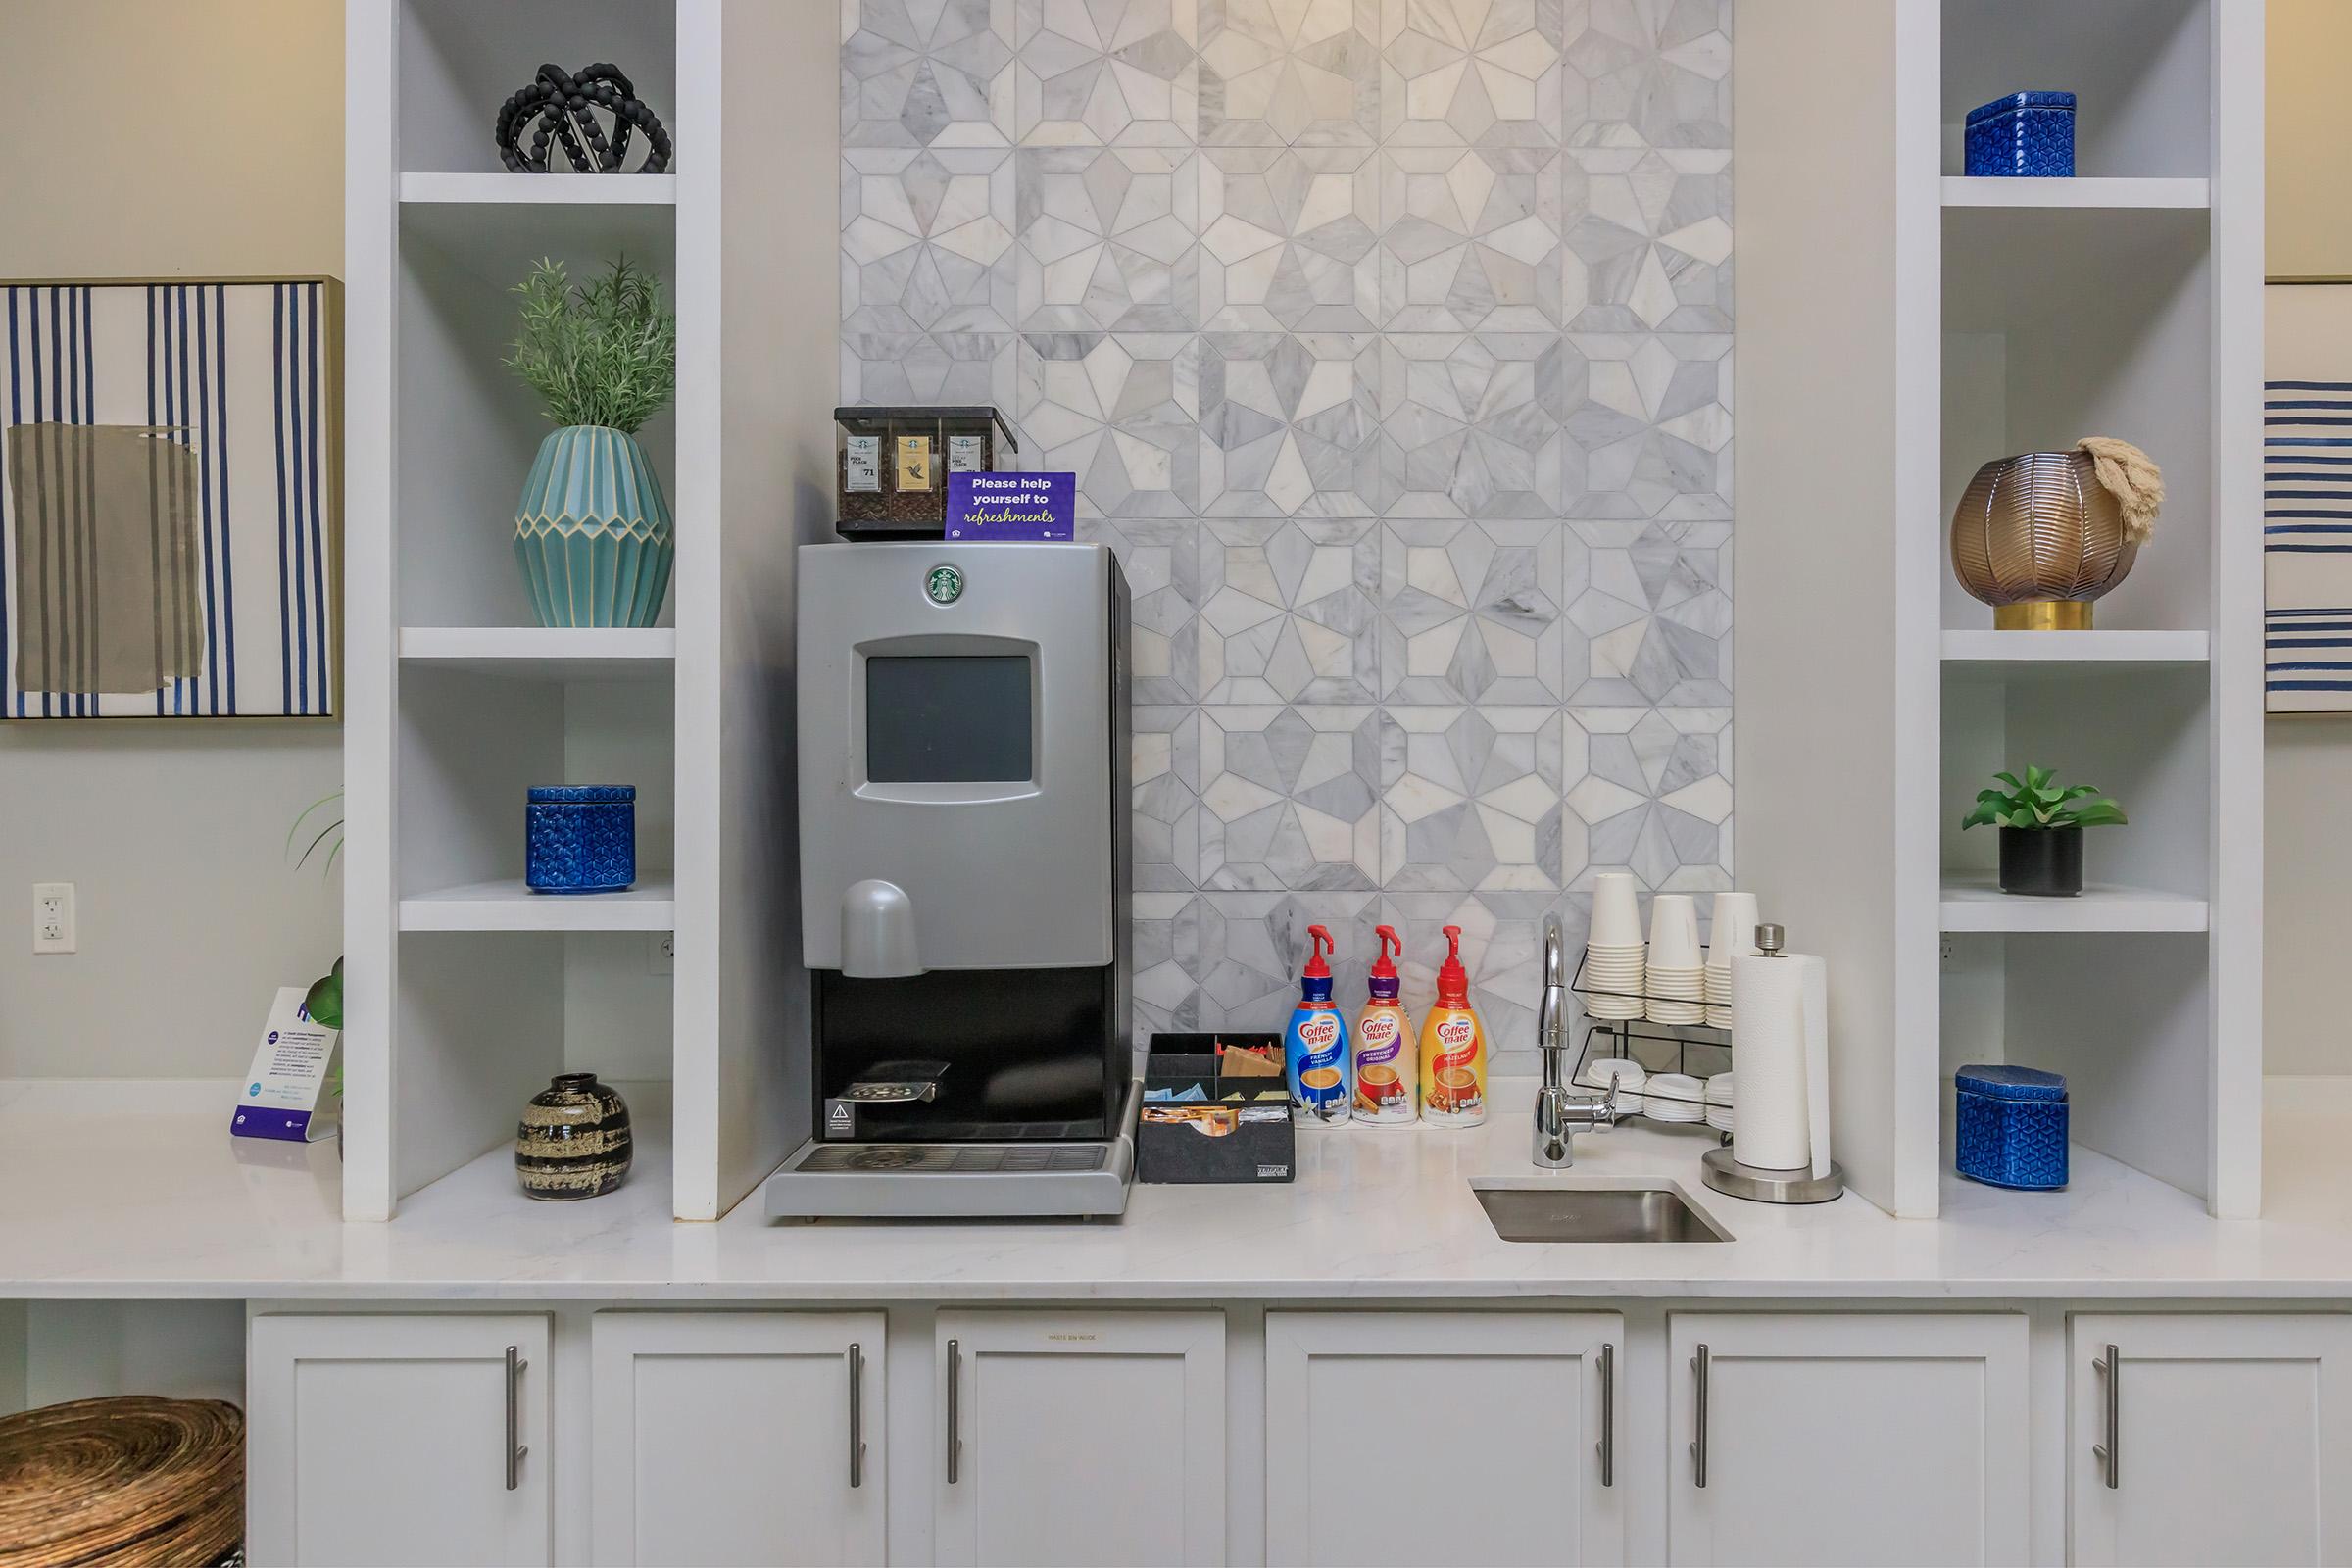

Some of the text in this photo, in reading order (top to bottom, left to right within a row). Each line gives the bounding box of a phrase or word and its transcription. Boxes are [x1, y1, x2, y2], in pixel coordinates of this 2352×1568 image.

[972, 478, 1052, 490] Please help
[973, 494, 1049, 506] yourself to
[964, 507, 1055, 526] refreshments
[1299, 1023, 1334, 1038] Coffee
[1362, 1019, 1394, 1034] Coffee
[1437, 1022, 1470, 1037] Coffee
[1308, 1033, 1333, 1045] mate
[1366, 1031, 1391, 1041] mate
[1444, 1034, 1469, 1044] mate
[1310, 1052, 1333, 1060] FRENCH
[1362, 1047, 1395, 1058] SWEETENED
[1366, 1054, 1391, 1062] ORIGINAL
[1444, 1050, 1472, 1062] HAZELNUT
[1310, 1056, 1333, 1065] VANILLA
